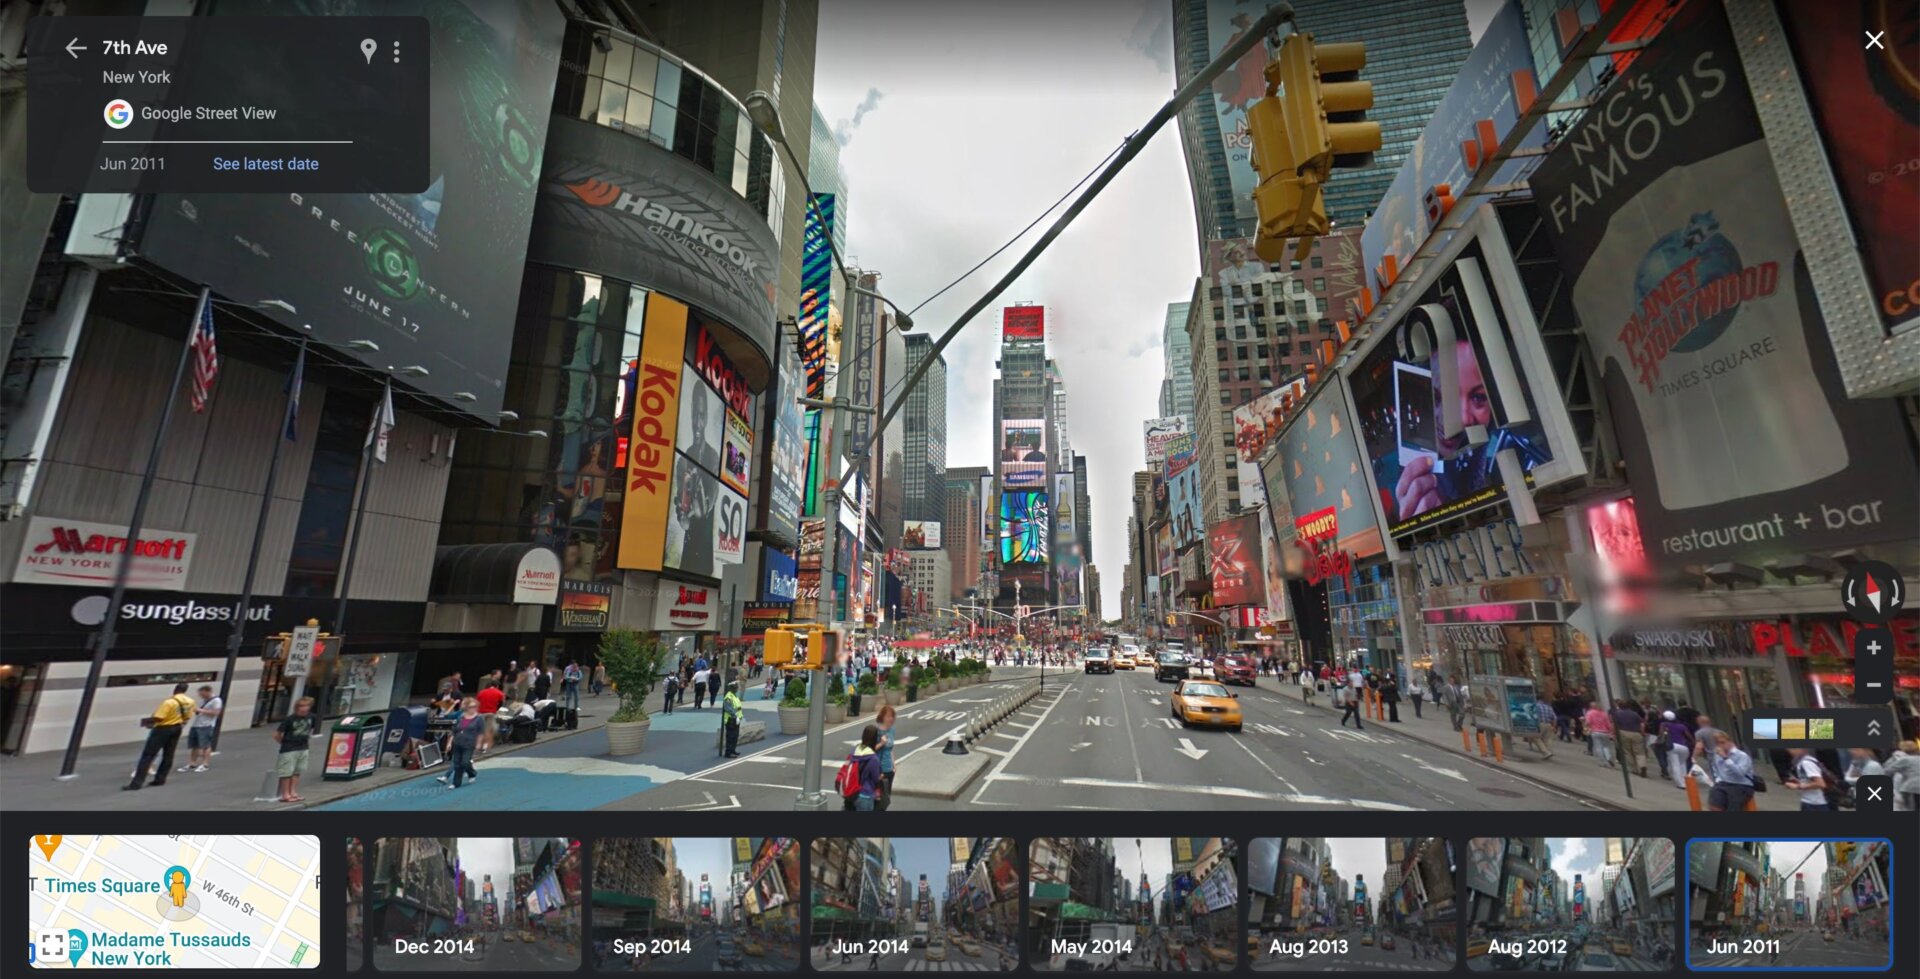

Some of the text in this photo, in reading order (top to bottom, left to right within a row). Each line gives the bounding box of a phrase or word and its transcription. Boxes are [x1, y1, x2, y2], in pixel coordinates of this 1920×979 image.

[1550, 51, 1727, 234] FAMOUS
[290, 192, 374, 255] GREEN
[389, 259, 470, 321] LANTERN
[648, 224, 707, 257] driving
[343, 285, 392, 318] JUNE
[402, 316, 420, 334] 17
[1617, 257, 1699, 367] PLANET
[1638, 261, 1780, 394] HOLLYWOOD
[694, 325, 752, 424] Kodak
[1658, 337, 1775, 398] TIMES SQUARE
[631, 363, 677, 496] Kodak
[719, 495, 743, 540] SO
[1305, 514, 1336, 538] WOODY?
[1661, 513, 1787, 556] restaurant
[1821, 500, 1884, 531] bar
[26, 555, 65, 567] NEW
[69, 558, 112, 569] YORK
[1411, 519, 1534, 590] FOREVER
[522, 569, 555, 580] Marriott
[563, 581, 611, 593] MARQUIS
[121, 600, 231, 626] sunglass
[561, 610, 607, 628] WONDERLAND
[296, 642, 308, 650] FOR
[297, 632, 313, 640] WAIT
[1635, 629, 1716, 648] SWAROVSKI
[291, 653, 308, 662] WALK
